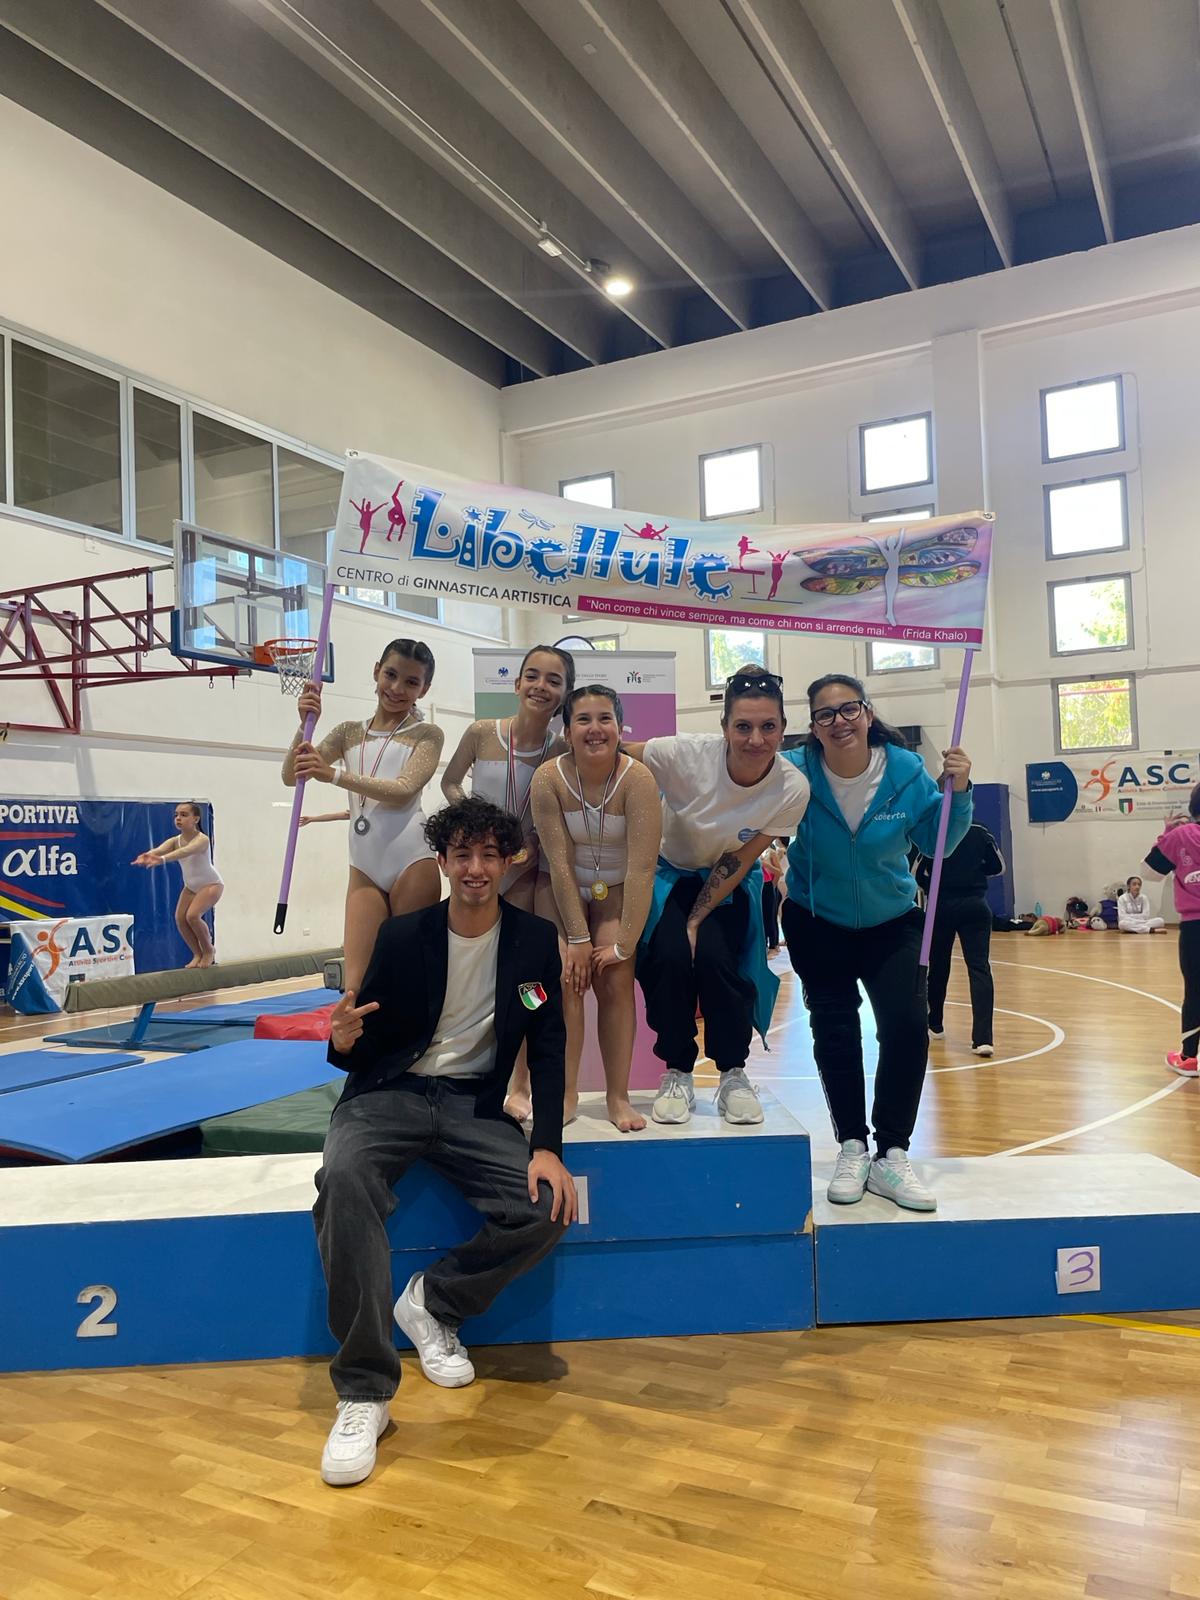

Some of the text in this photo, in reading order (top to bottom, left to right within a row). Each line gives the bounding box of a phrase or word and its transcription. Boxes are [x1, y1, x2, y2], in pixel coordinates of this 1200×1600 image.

[408, 486, 732, 600] Libellule
[336, 566, 572, 608] CENTRO di GINNASTICA ARTISTICA
[613, 604, 641, 614] come
[643, 606, 657, 616] chi
[660, 608, 686, 619] vince
[688, 611, 727, 624] sempre,
[730, 616, 745, 625] ma
[748, 617, 775, 627] come
[777, 618, 792, 628] chi
[794, 621, 813, 630] non
[815, 621, 824, 631] si
[826, 622, 864, 634] arrende
[902, 628, 968, 642] (Frida Khalo)
[1117, 763, 1196, 788] A.S.C.
[1067, 1251, 1094, 1286] 3
[76, 1284, 118, 1338] 2
